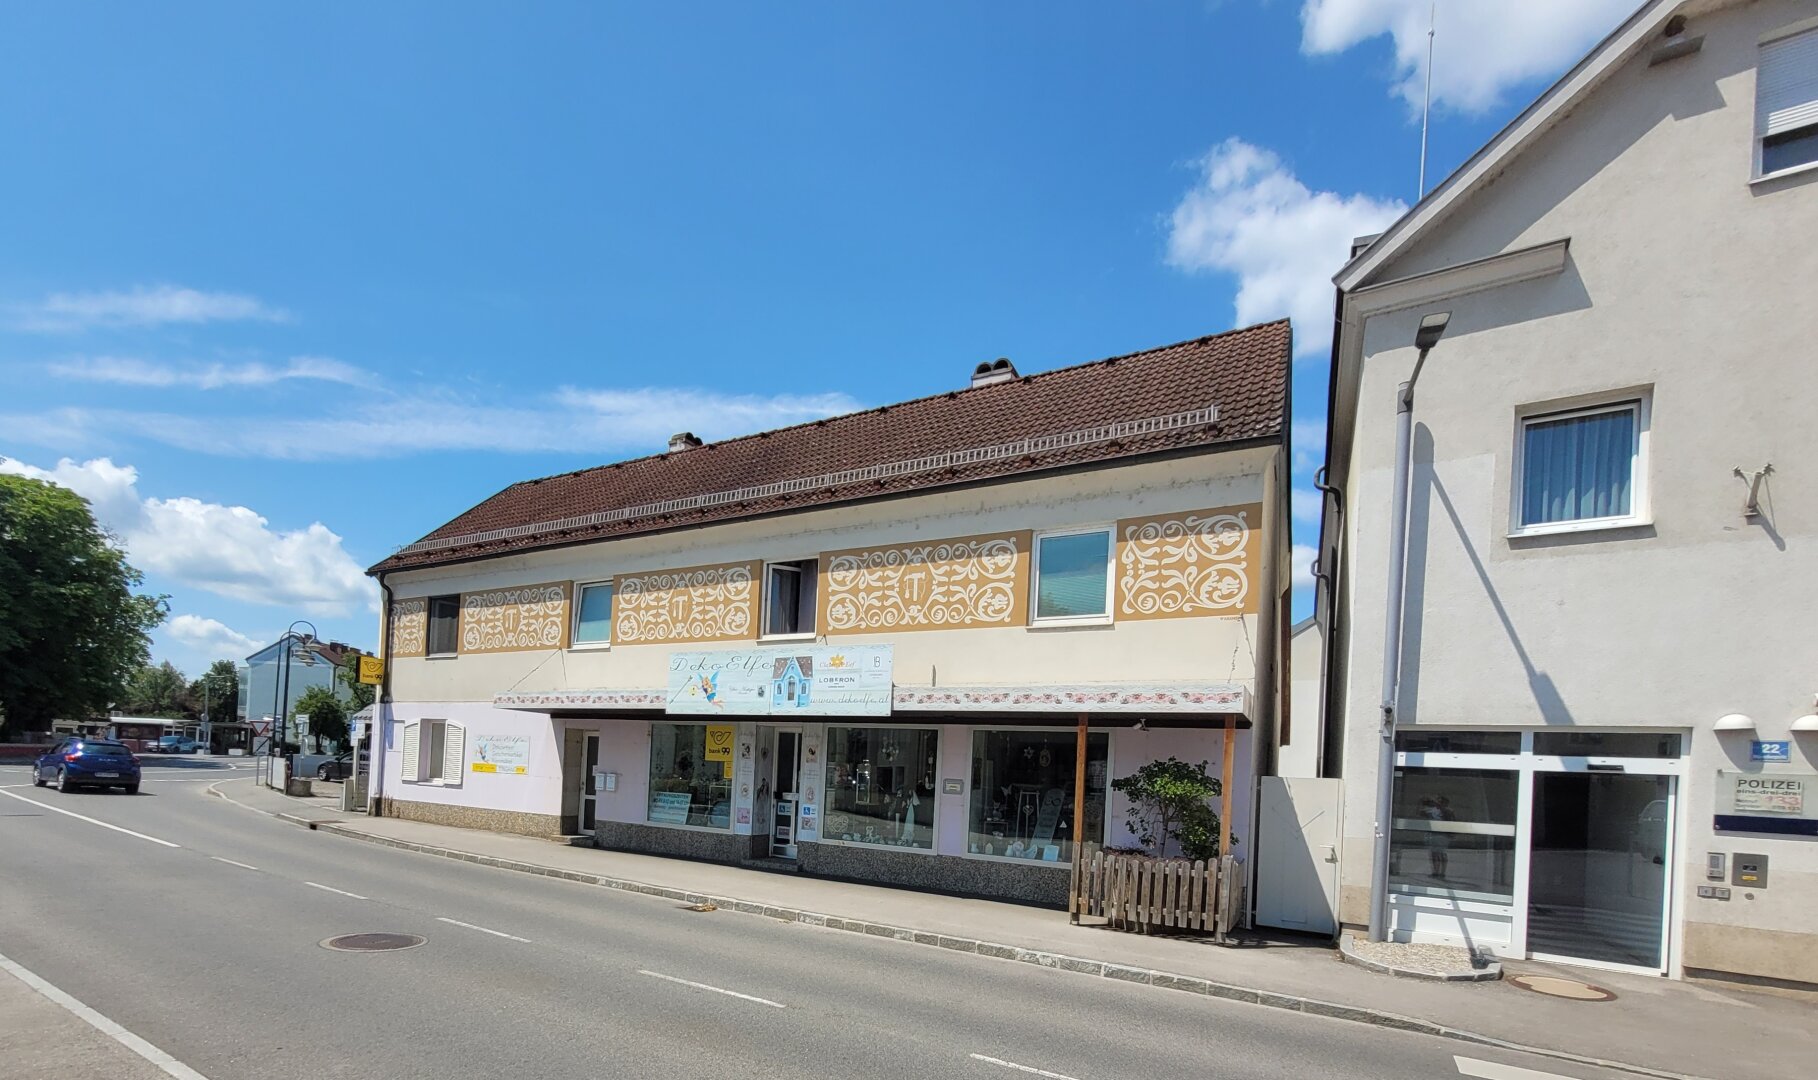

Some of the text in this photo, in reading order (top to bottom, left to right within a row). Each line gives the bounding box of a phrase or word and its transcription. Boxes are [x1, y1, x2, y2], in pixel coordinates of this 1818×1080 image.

[669, 655, 776, 678] Deko Elfe
[374, 673, 383, 681] 99
[721, 747, 731, 756] 99
[1761, 743, 1780, 754] 22
[1737, 779, 1801, 790] POLIZEI
[1736, 788, 1801, 796] eins-drei-drei
